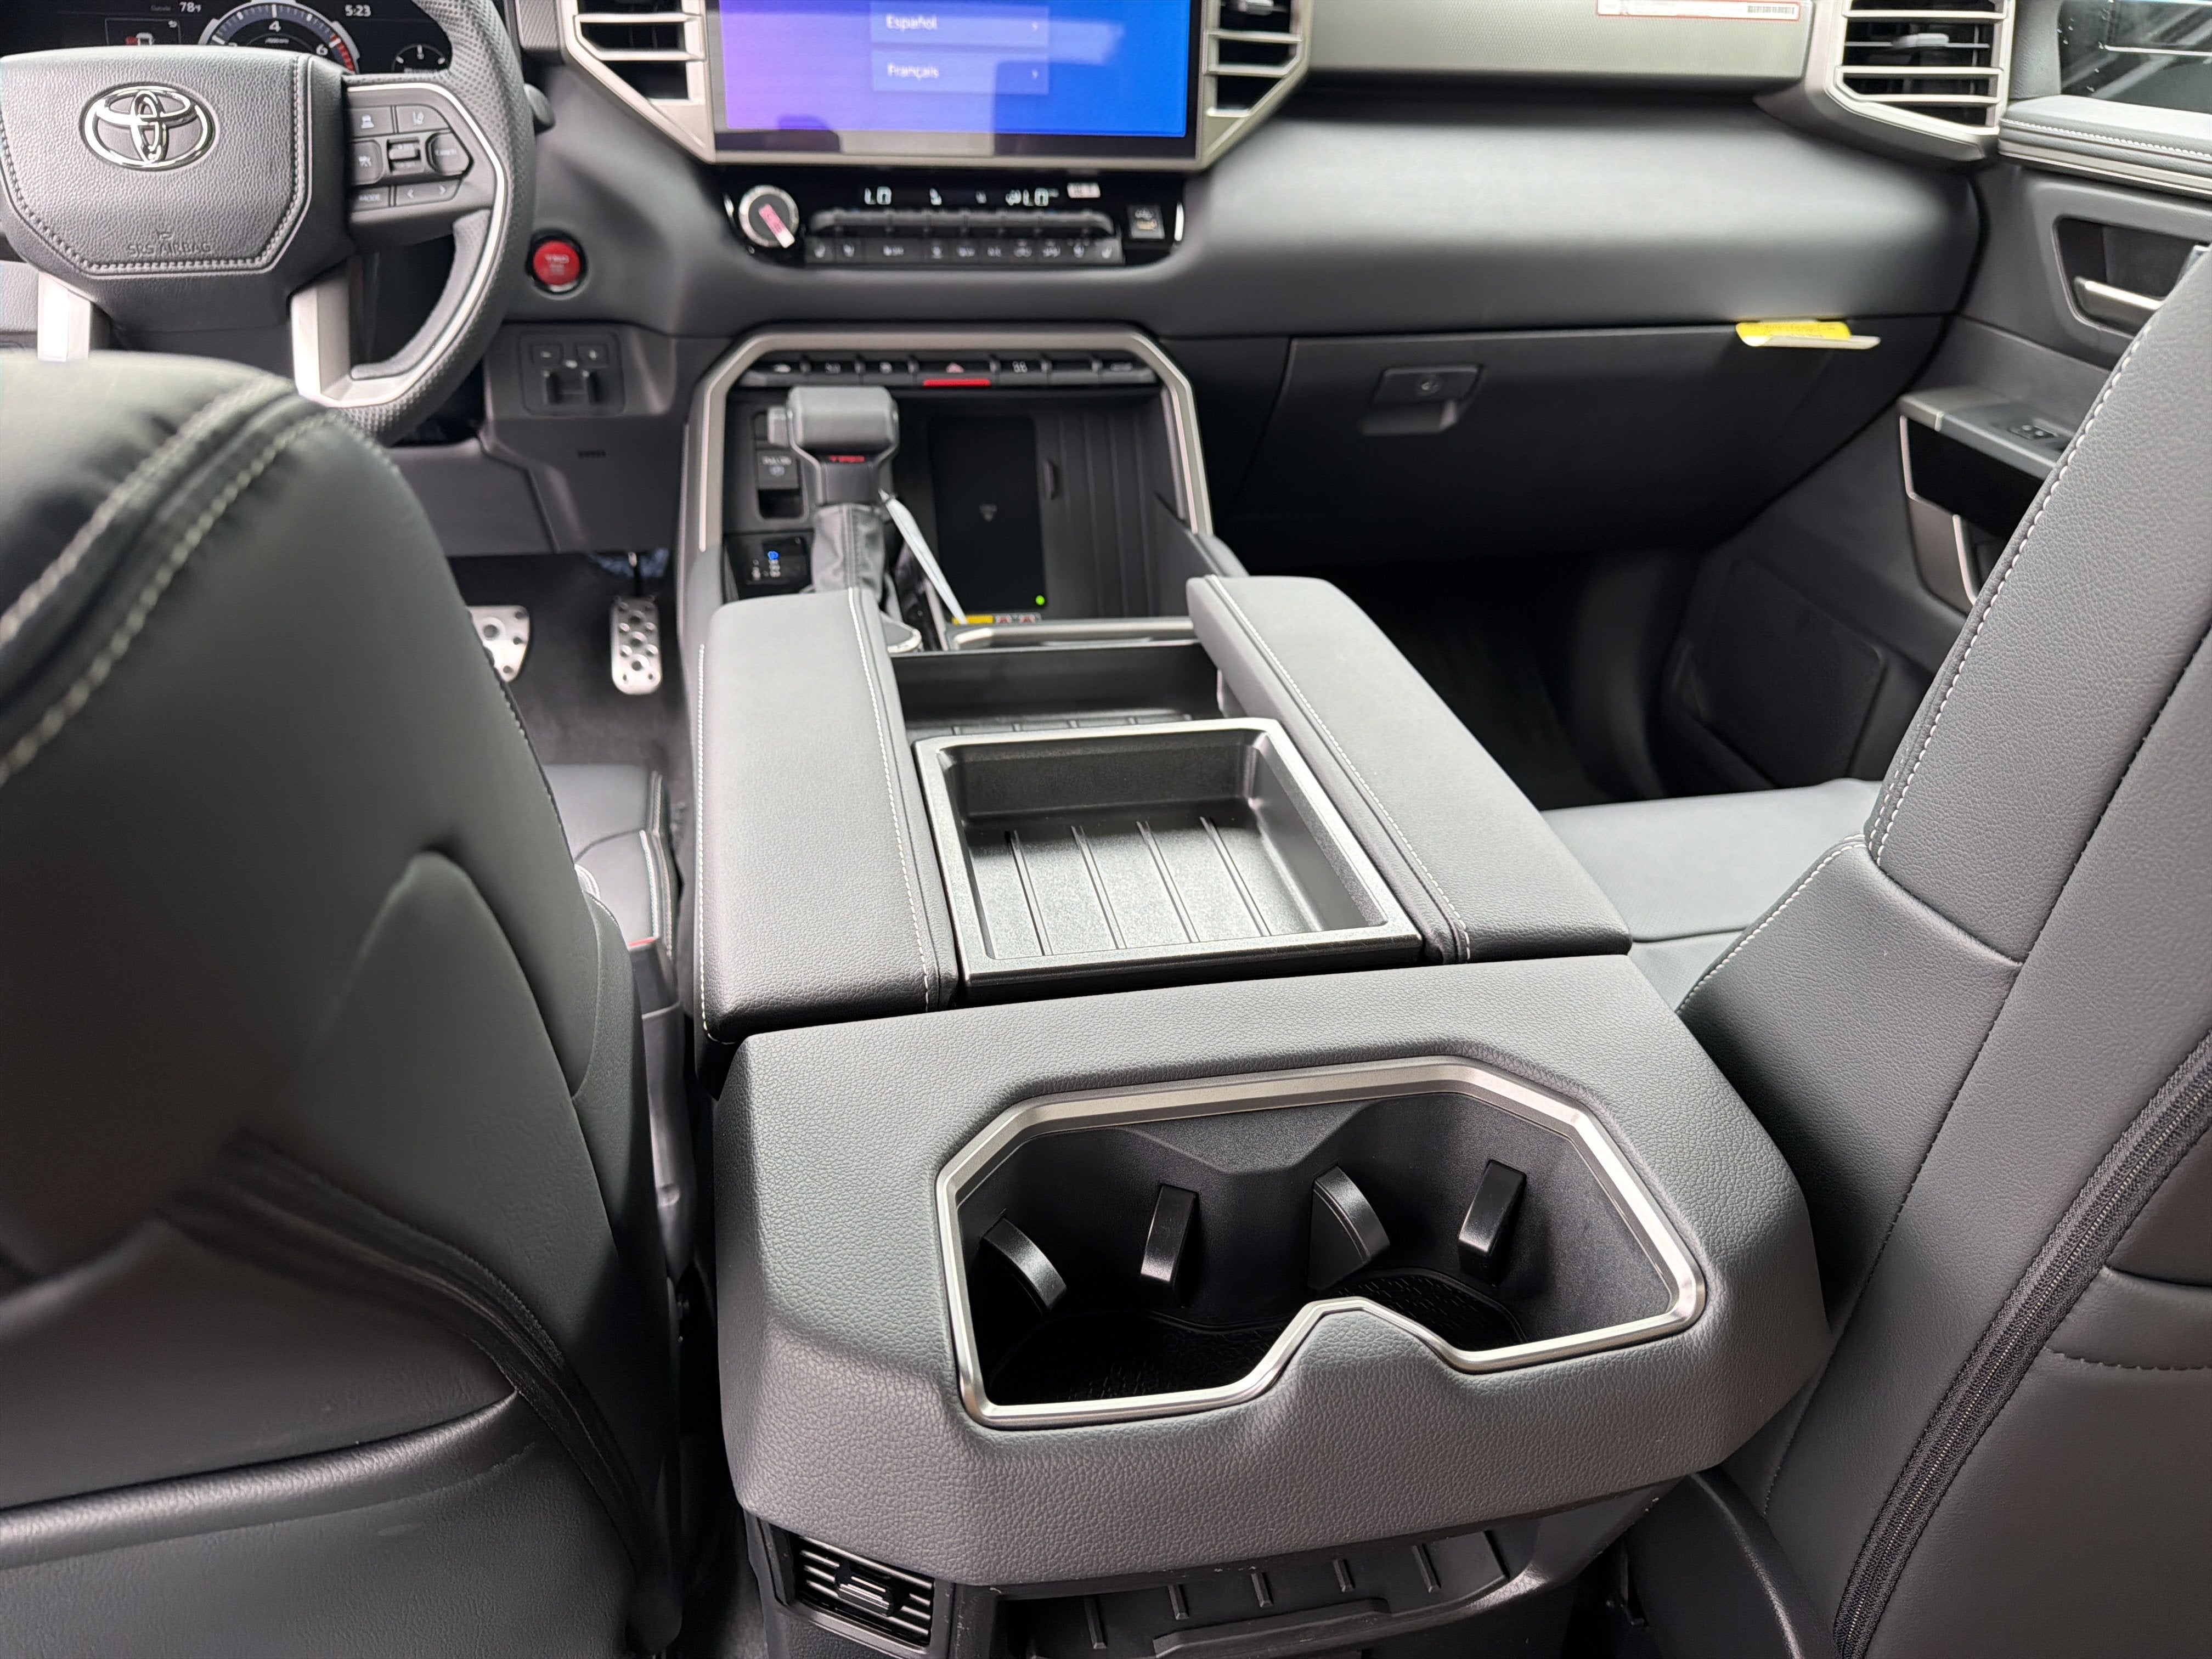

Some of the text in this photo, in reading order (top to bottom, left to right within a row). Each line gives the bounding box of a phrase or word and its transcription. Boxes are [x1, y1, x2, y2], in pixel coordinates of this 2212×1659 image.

[345, 4, 371, 16] 5:23
[269, 21, 281, 32] 4
[886, 14, 938, 31] Español
[316, 44, 328, 55] 6
[887, 63, 939, 80] Français
[127, 241, 213, 257] SRS AIRBAG
